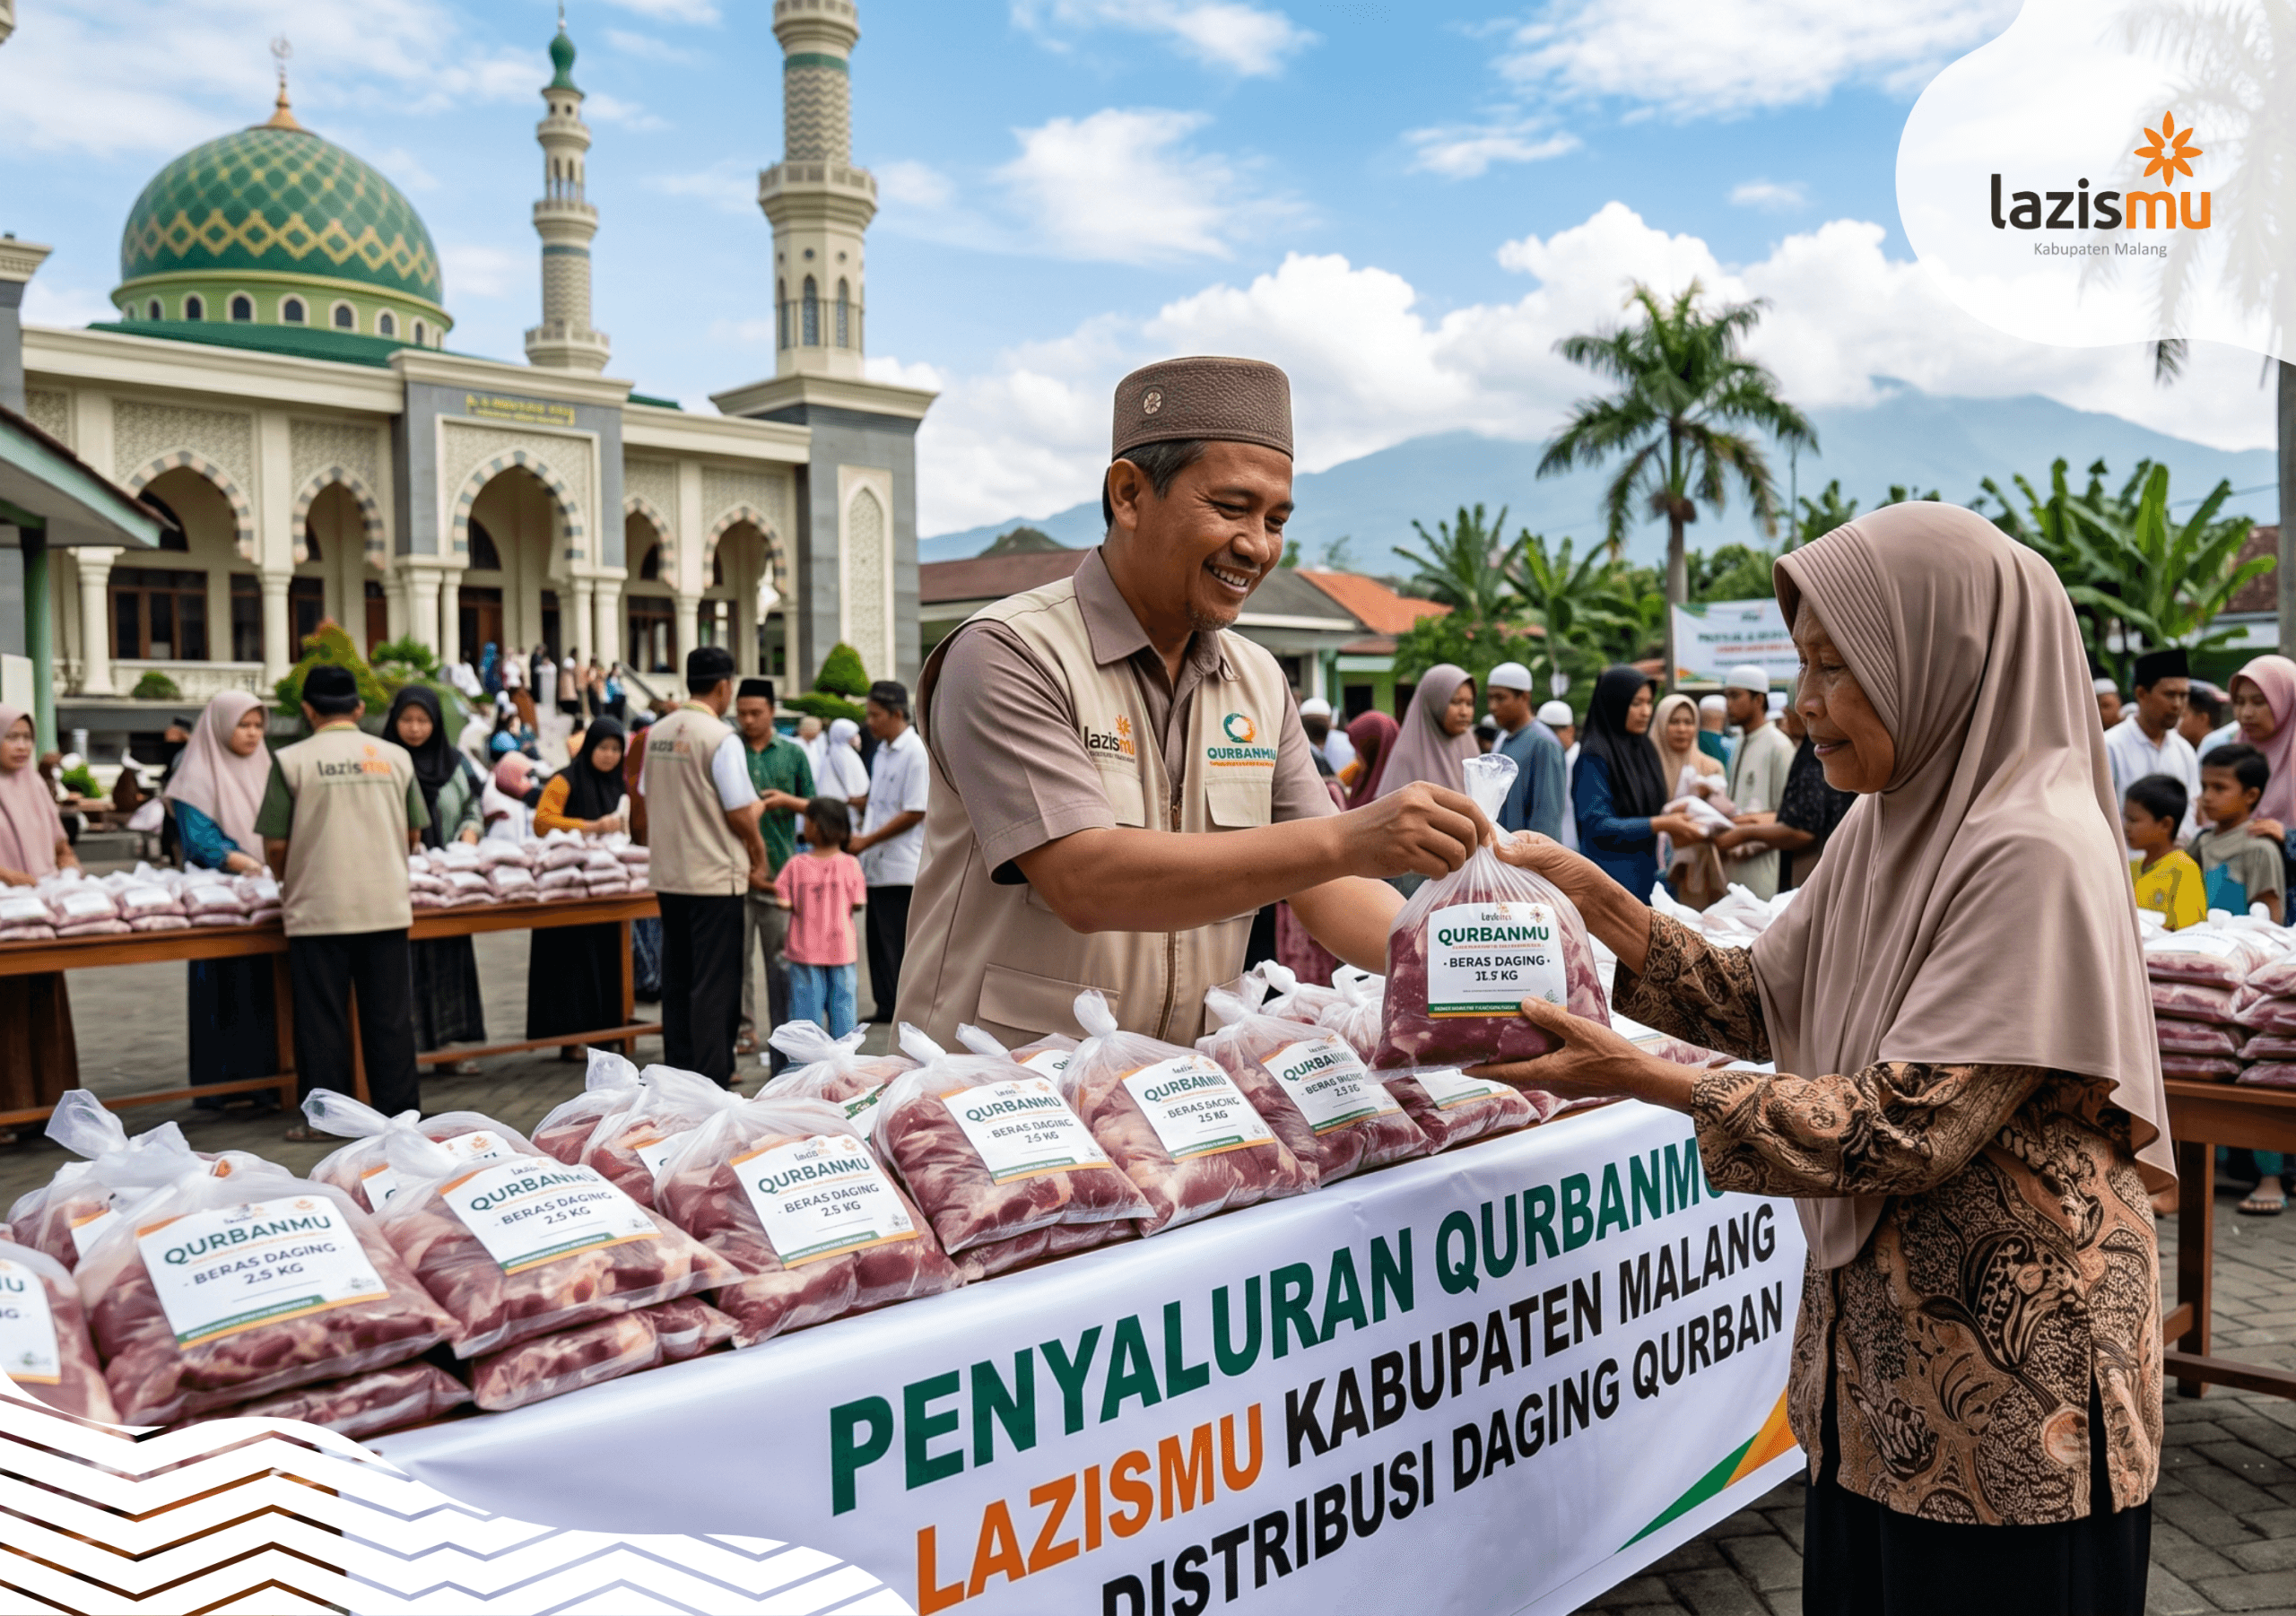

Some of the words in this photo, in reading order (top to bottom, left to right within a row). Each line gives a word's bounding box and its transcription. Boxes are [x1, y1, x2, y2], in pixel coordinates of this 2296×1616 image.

[1083, 725, 1135, 756] lazismu
[1438, 926, 1550, 946] QURBANMU
[1449, 957, 1492, 968] BERAS
[1494, 955, 1545, 967] DAGING
[1500, 969, 1518, 981] KG
[965, 1096, 1062, 1123] QURBANMU
[991, 1123, 1031, 1139] BERAS
[1043, 1131, 1059, 1141] KG
[470, 1171, 599, 1212] QURBANMU
[758, 1157, 871, 1195] QURBANMU
[501, 1201, 557, 1226] BERAS
[557, 1191, 613, 1209] DAGING
[785, 1193, 831, 1214] BERAS
[832, 1182, 880, 1201] DAGING
[820, 1205, 841, 1218] 2.5
[843, 1200, 862, 1212] KG
[544, 1211, 569, 1226] 2.5
[570, 1205, 592, 1219] KG
[163, 1215, 333, 1265] QURBANMU
[193, 1255, 260, 1286] BERAS
[264, 1242, 337, 1264] DAGING
[243, 1266, 274, 1285] 2.5
[276, 1262, 304, 1277] KG
[829, 1227, 1415, 1517] PENYALURAN
[1435, 1136, 1726, 1296] QURBANM
[916, 1403, 1265, 1616] LAZISMU
[1284, 1270, 1603, 1469] KABUPATEN
[1618, 1203, 1776, 1325] MALANG
[1101, 1438, 1435, 1616] DISTRIBUSI
[1452, 1357, 1620, 1493] DAGING
[1632, 1281, 1783, 1400] QURBAN
